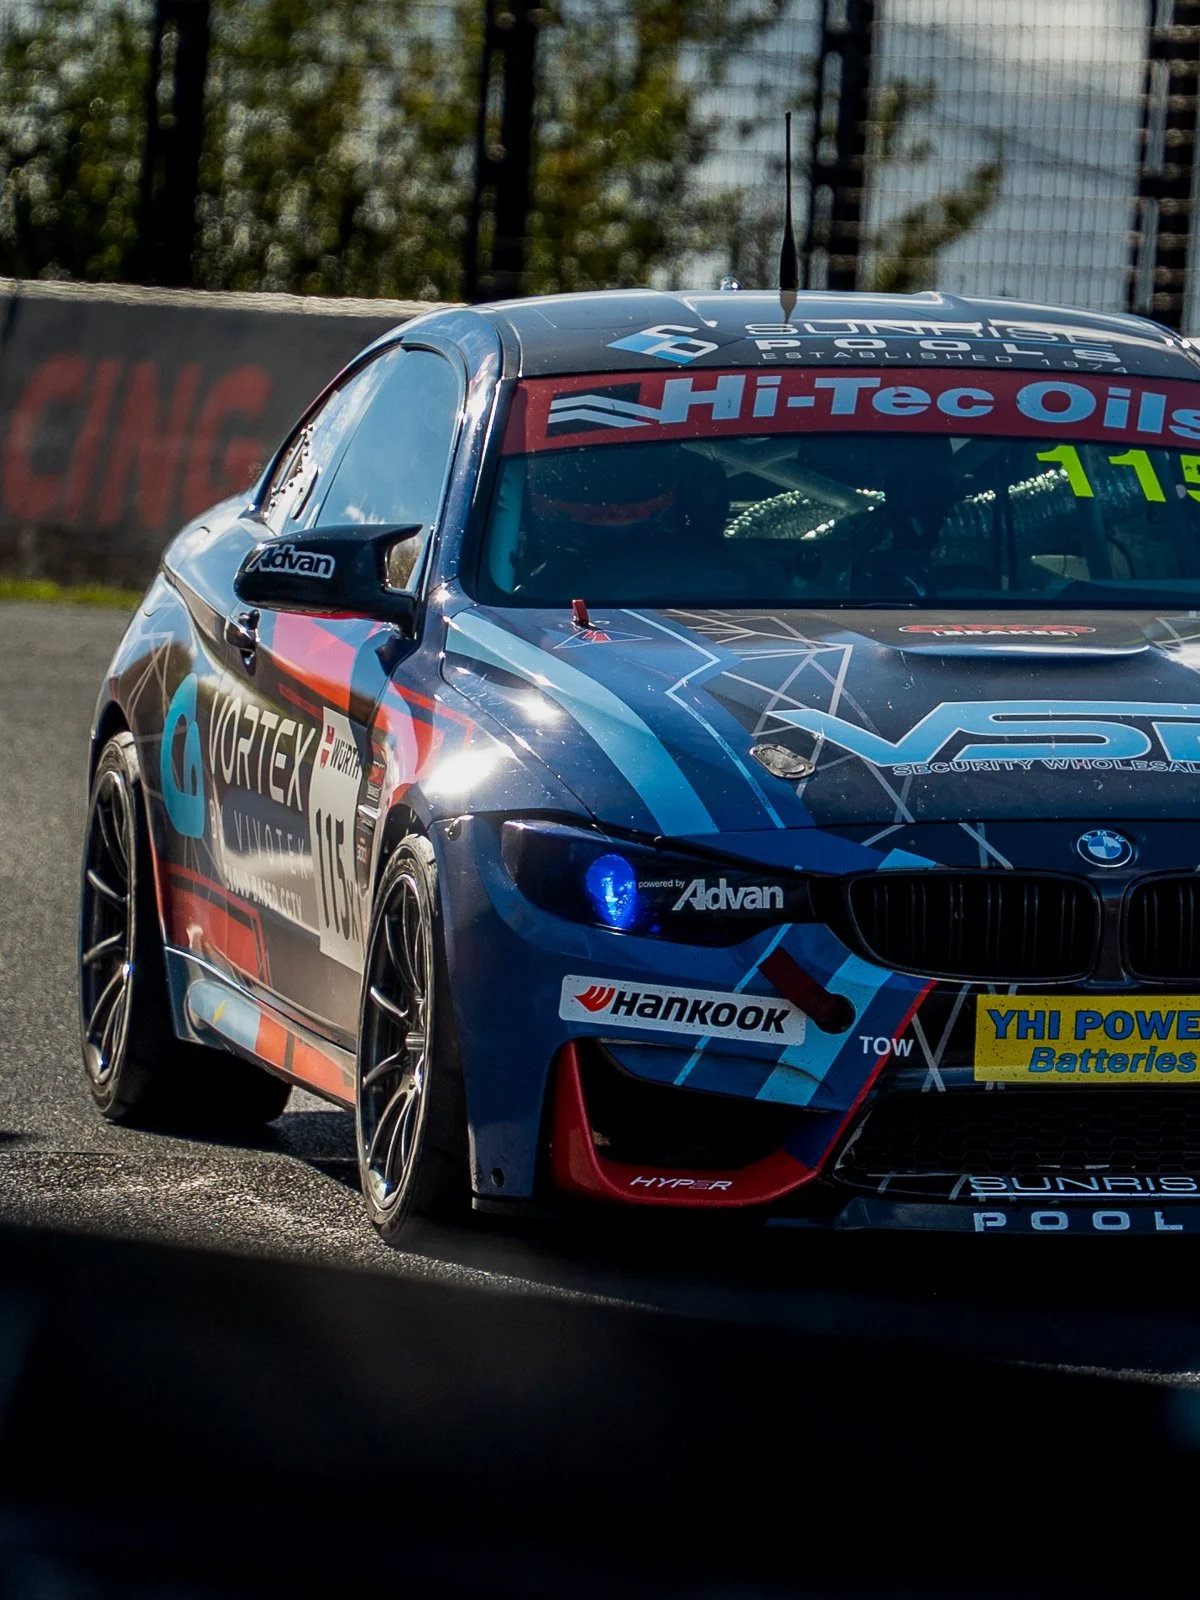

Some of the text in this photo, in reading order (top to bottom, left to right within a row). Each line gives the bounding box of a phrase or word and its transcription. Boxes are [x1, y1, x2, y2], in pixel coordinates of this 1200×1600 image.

[745, 322, 1112, 348] SUNRISE
[755, 339, 1121, 363] POOLS
[762, 350, 1128, 374] ESTABLISHED 1974
[659, 374, 995, 424] Hi-Tec
[246, 544, 335, 578] Advan
[208, 691, 317, 812] VORTEX
[330, 737, 361, 781] WÜRTH
[893, 759, 1034, 776] SECURITY
[233, 808, 308, 881] VIVOTEK
[638, 878, 784, 911] powered by Advan
[987, 1009, 1061, 1040] YHI
[858, 1035, 914, 1057] TOW
[1028, 1046, 1199, 1074] Batteries
